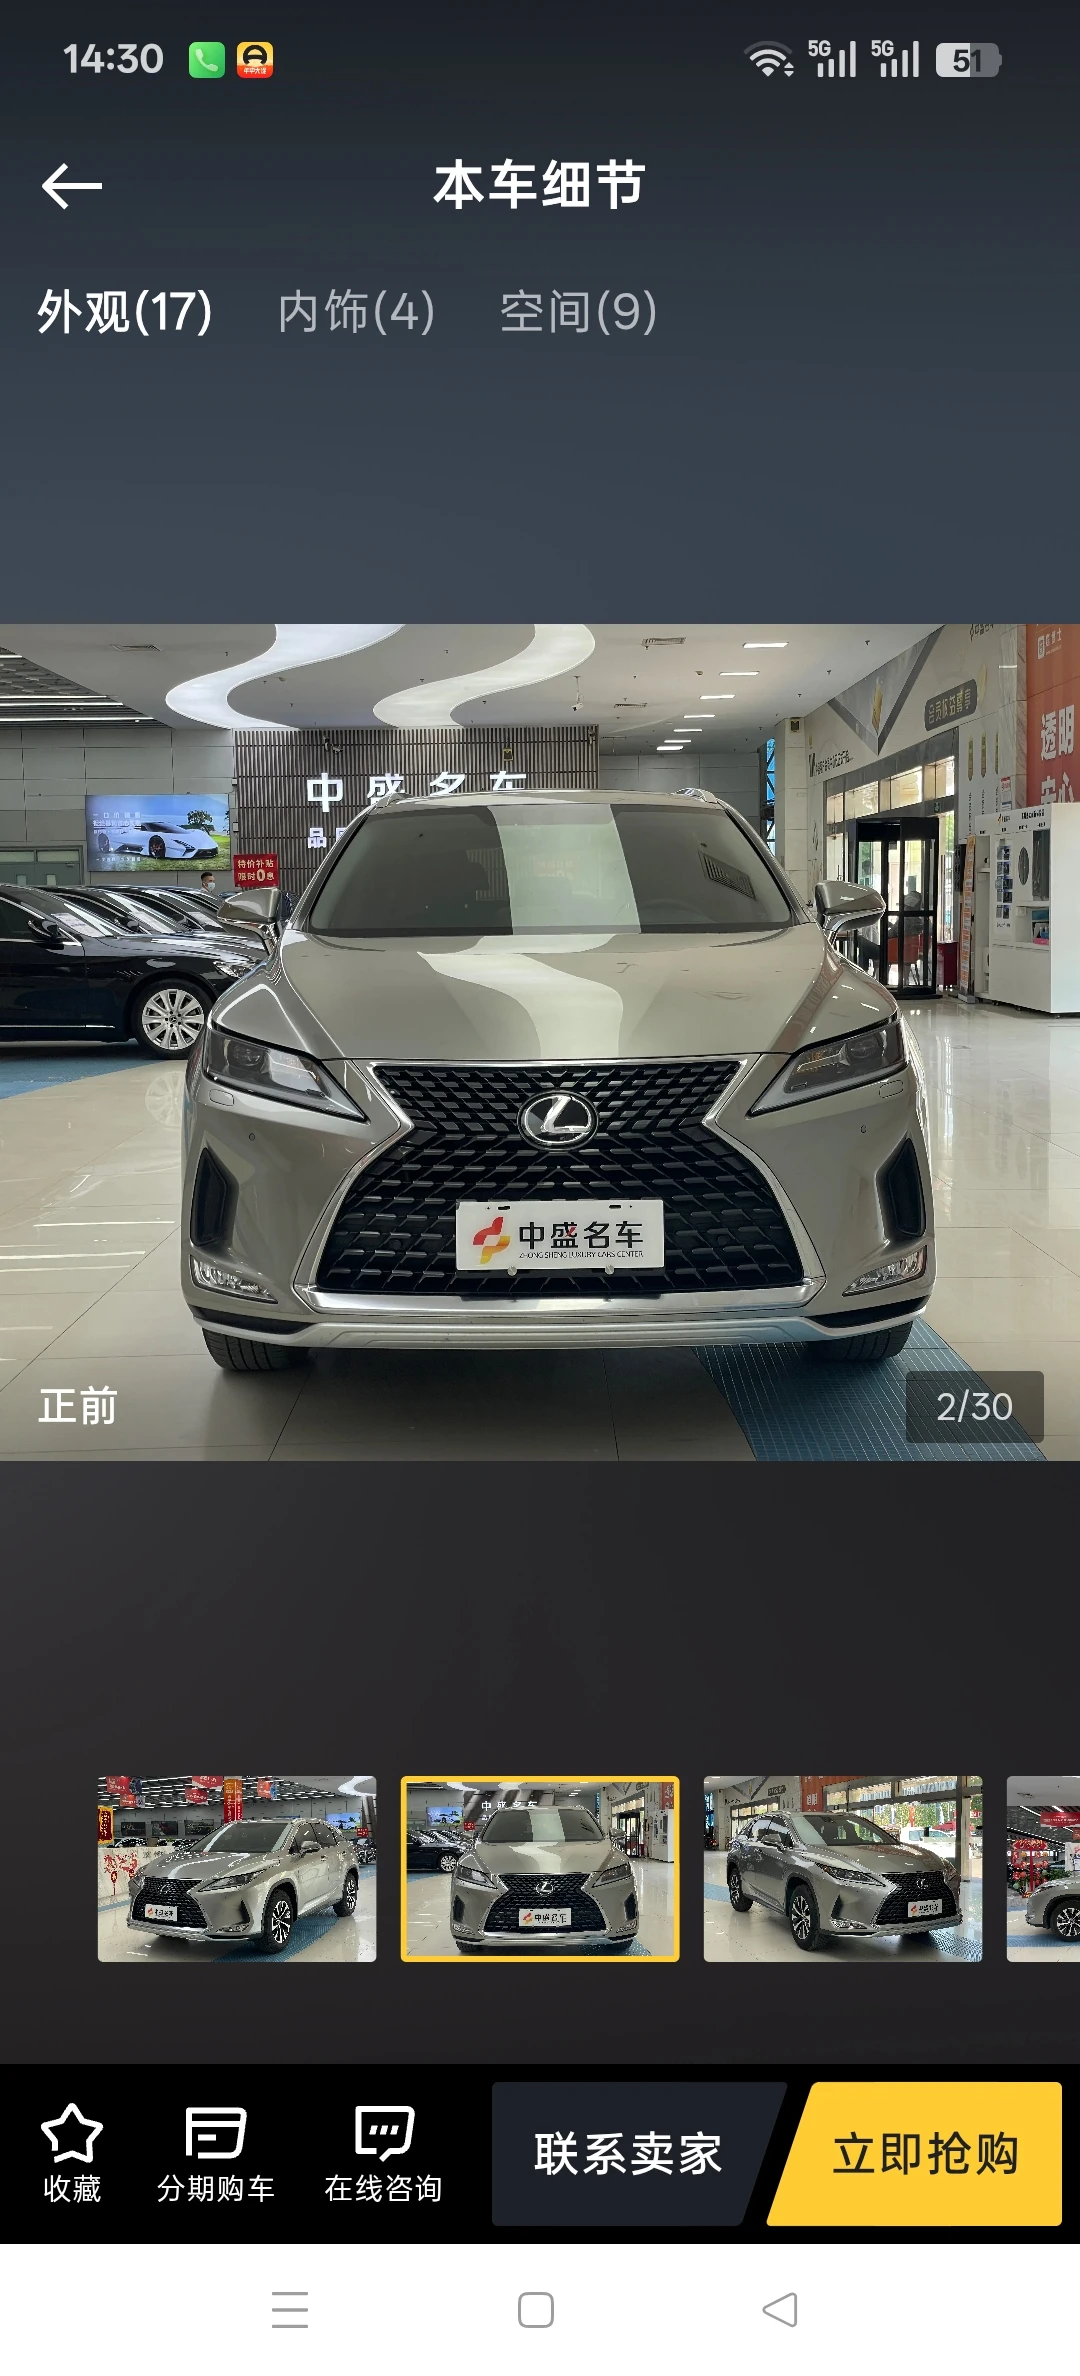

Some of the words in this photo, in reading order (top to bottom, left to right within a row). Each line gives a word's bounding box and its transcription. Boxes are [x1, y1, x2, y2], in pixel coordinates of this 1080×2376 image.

[64, 43, 163, 73] 14:30
[808, 40, 831, 56] 5G
[871, 40, 894, 56] 5G
[953, 49, 981, 72] 51
[433, 158, 645, 209] 本车细节
[37, 289, 211, 336] 外观(17)
[278, 289, 434, 336] 内饰(4)
[501, 289, 656, 336] 空间(9)
[1041, 705, 1074, 760] 透明
[238, 859, 274, 869] 特价补贴
[238, 869, 275, 882] 限时0息
[519, 1221, 643, 1249] 中盛名车
[519, 1251, 543, 1259] ZHONG
[544, 1251, 568, 1259] SHENG
[616, 1250, 644, 1258] CENTER
[534, 2131, 722, 2175] 联系卖家
[833, 2131, 1018, 2175] 立即抢购
[43, 2174, 101, 2203] 收藏
[157, 2174, 275, 2203] 分期购车
[325, 2174, 442, 2203] 在线咨询
